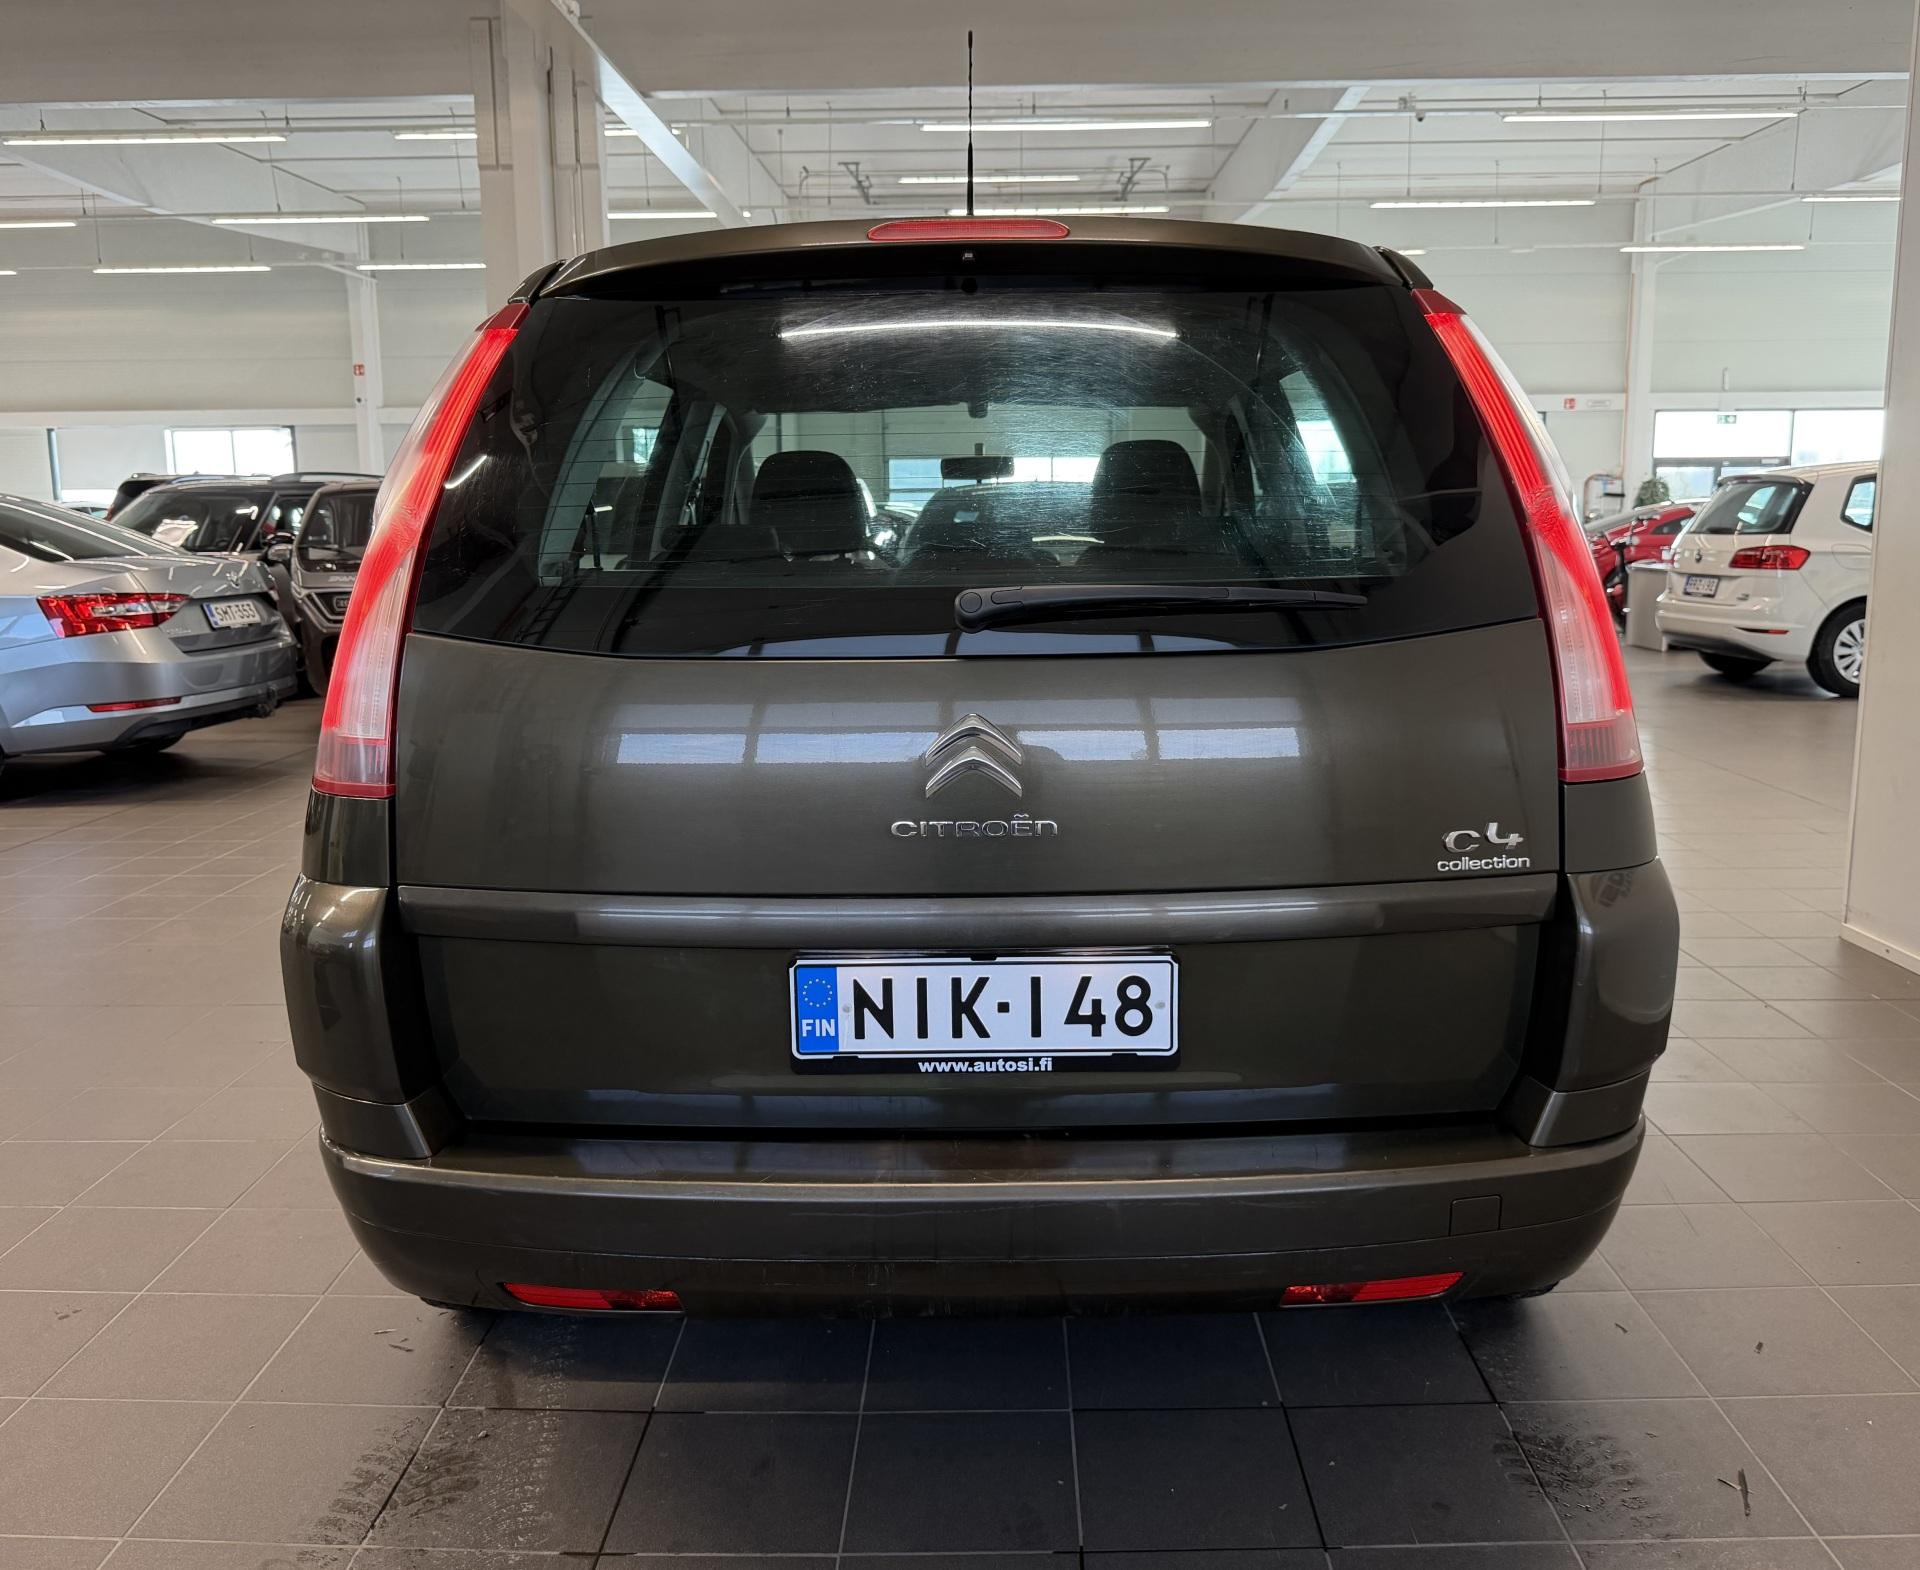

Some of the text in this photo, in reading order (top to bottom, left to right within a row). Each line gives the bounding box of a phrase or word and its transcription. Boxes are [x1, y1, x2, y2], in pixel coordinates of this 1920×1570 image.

[1442, 821, 1524, 852] C4
[1437, 855, 1530, 871] collection
[852, 975, 1154, 1040] NIK-148
[801, 1018, 836, 1037] FIN
[917, 1057, 1053, 1073] www.autosi.fi
